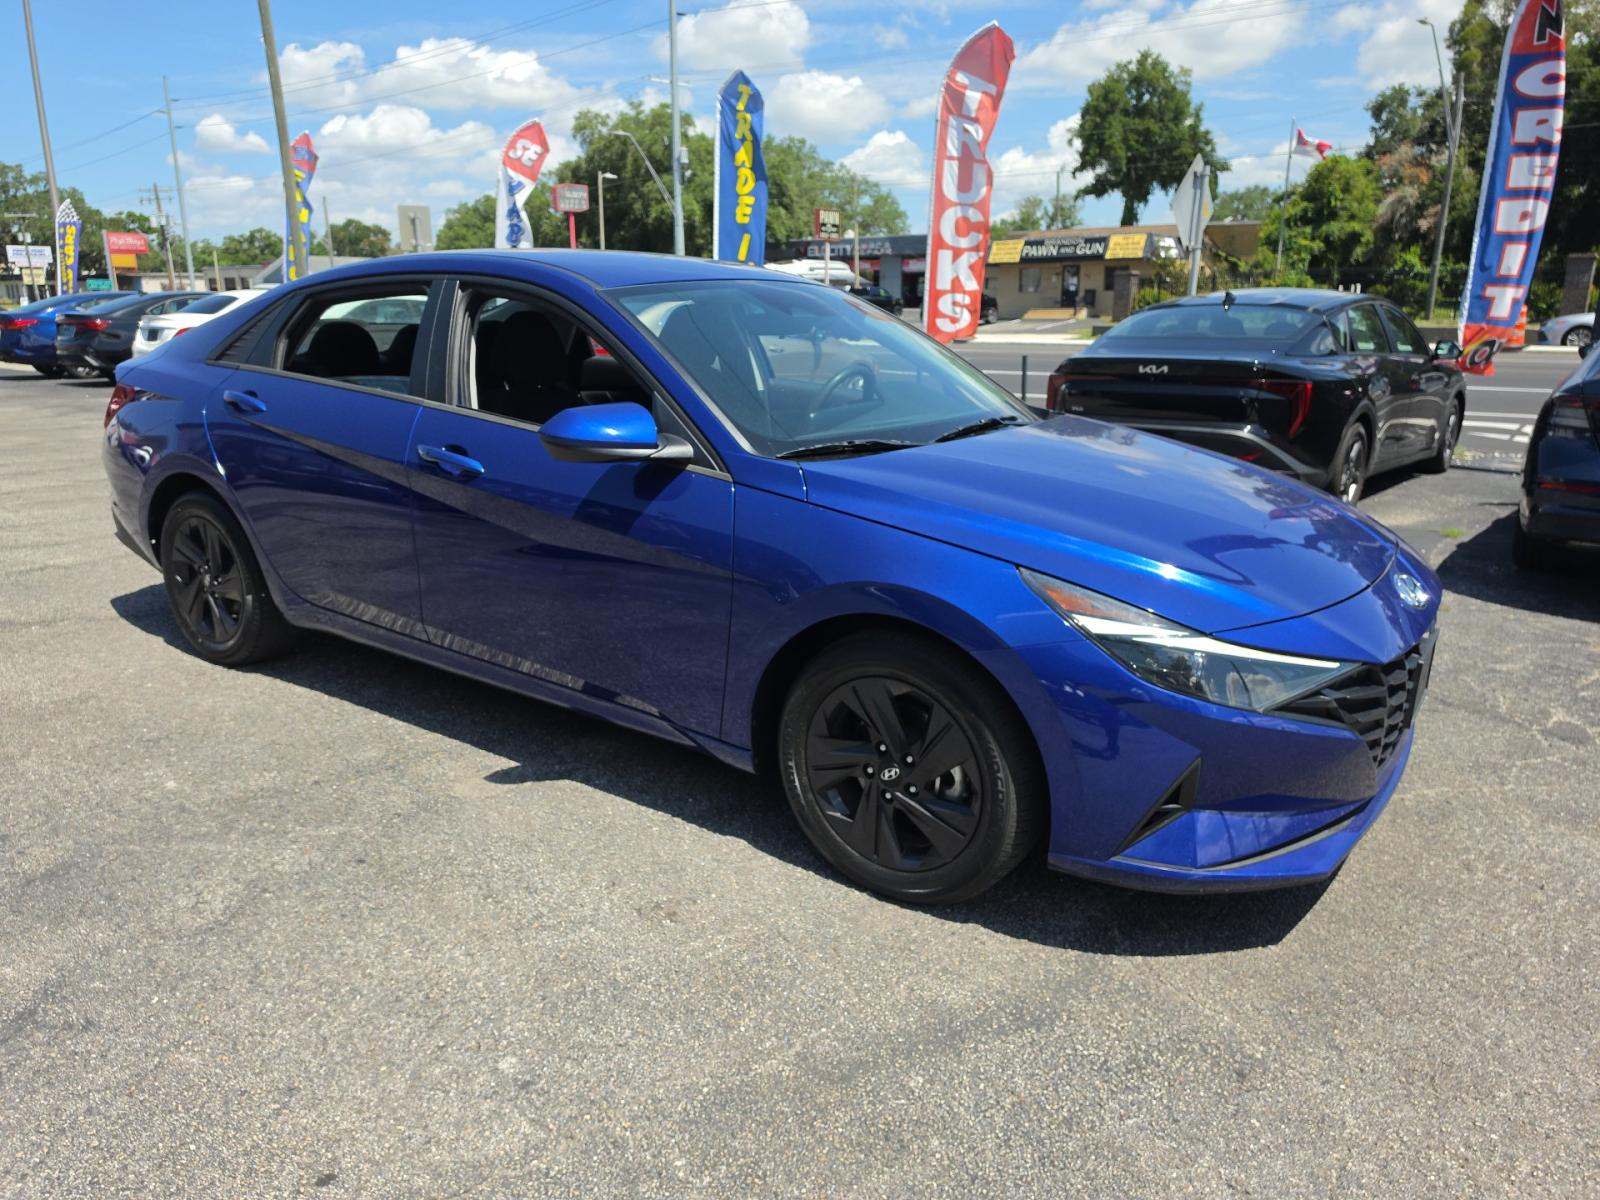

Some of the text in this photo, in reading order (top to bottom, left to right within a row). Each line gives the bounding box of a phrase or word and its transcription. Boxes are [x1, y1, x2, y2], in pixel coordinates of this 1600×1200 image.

[507, 138, 544, 168] SE
[734, 83, 757, 263] TRADE I
[935, 71, 998, 333] TRUCKS
[1022, 243, 1059, 257] PAWN
[1076, 241, 1106, 255] GUN
[1138, 364, 1169, 374] KIA
